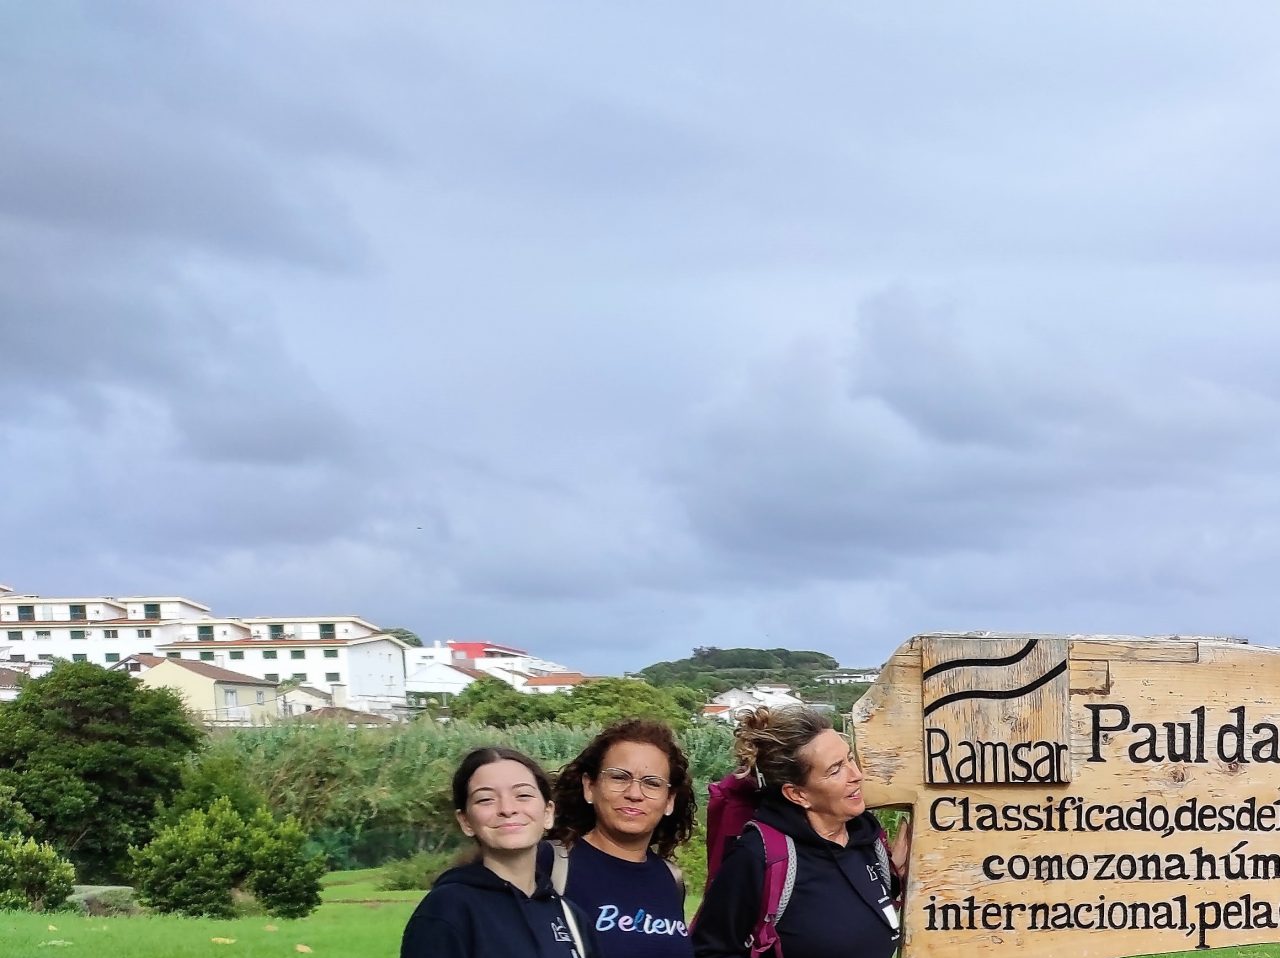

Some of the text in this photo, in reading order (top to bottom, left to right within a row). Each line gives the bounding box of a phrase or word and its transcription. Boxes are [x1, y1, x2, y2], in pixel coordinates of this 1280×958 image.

[926, 727, 1068, 782] Ramsar
[1084, 703, 1208, 764] Paul
[929, 796, 1174, 838] Classificado,
[1175, 797, 1272, 832] desde
[982, 854, 1089, 883] como
[1093, 853, 1190, 881] zona
[595, 904, 689, 937] Believe
[922, 895, 1195, 937] internacional,
[1195, 894, 1278, 950] pela
